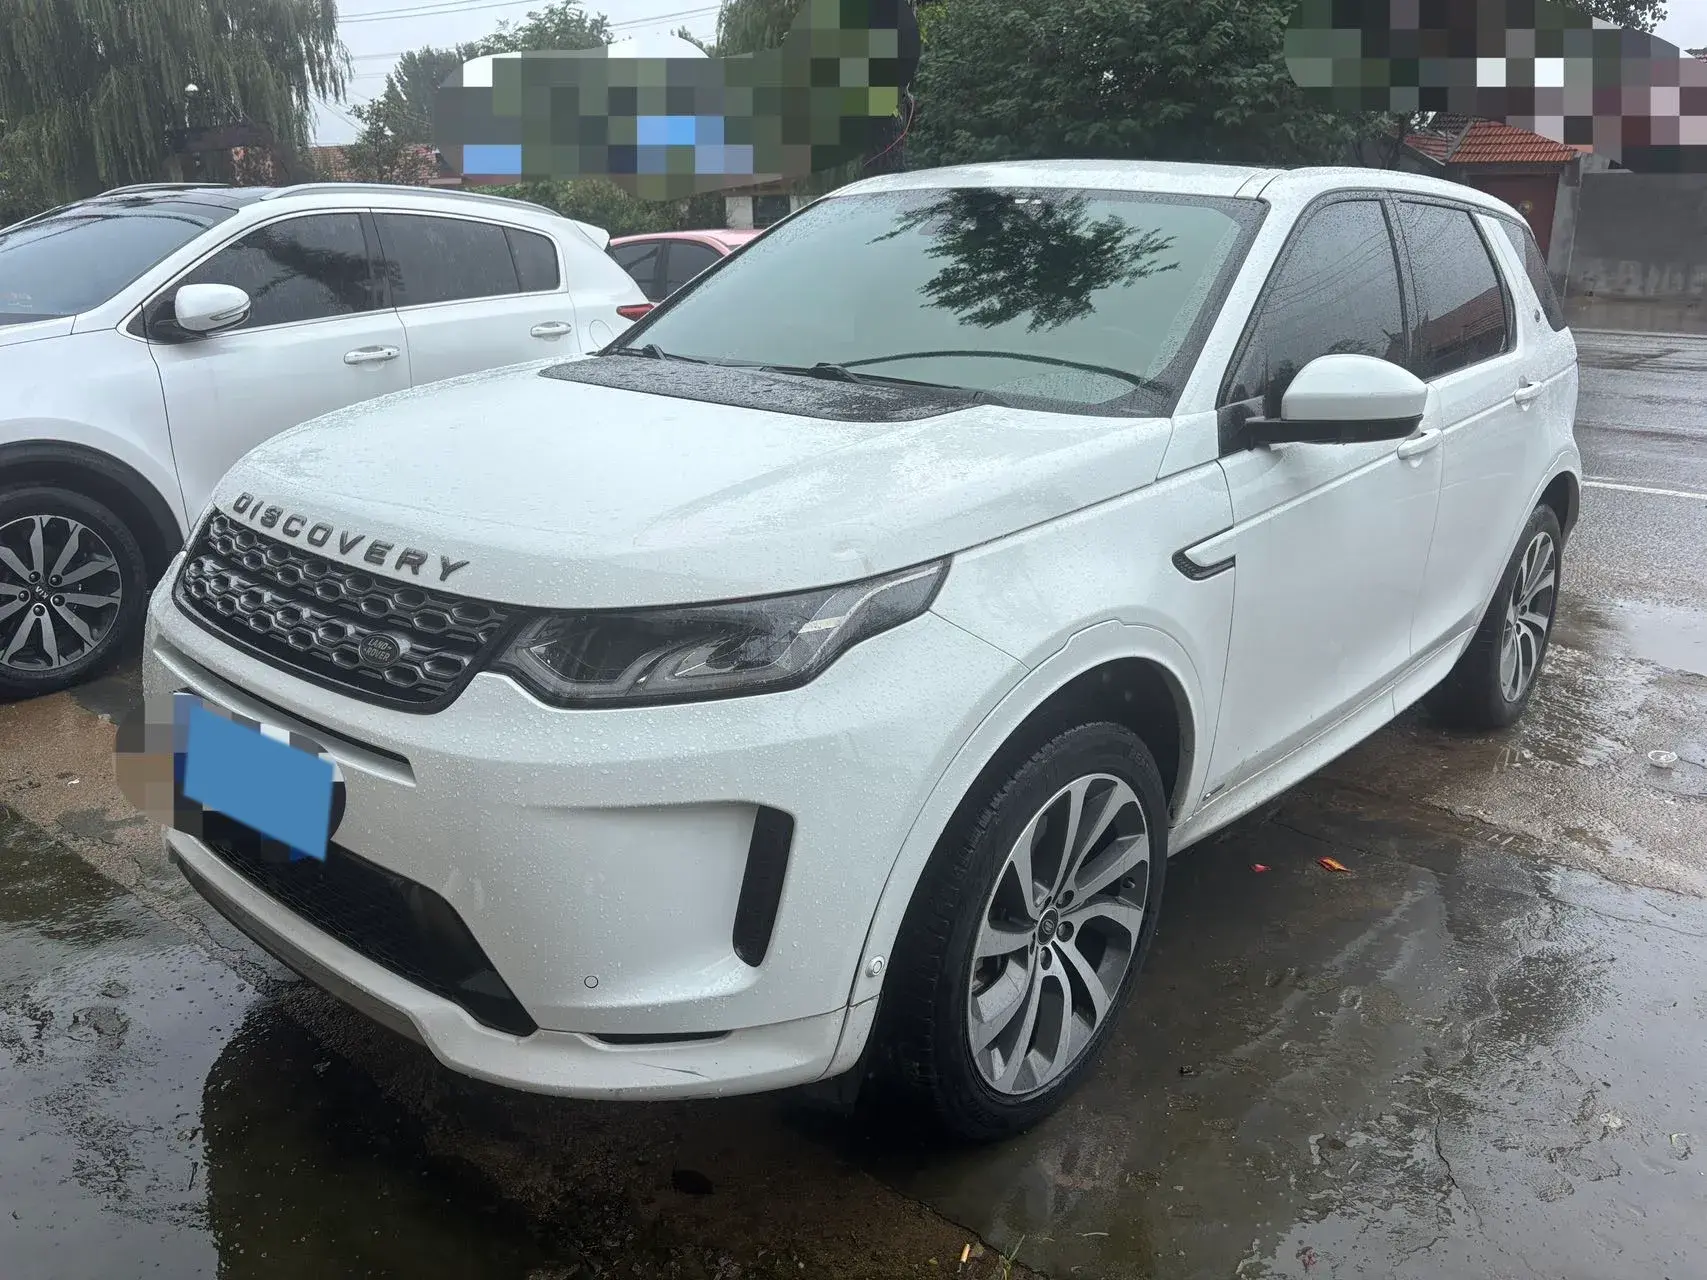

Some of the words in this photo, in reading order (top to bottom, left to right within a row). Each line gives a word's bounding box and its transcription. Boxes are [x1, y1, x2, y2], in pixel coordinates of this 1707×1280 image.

[233, 492, 470, 581] DISCOVERY
[368, 638, 389, 650] LAND
[365, 646, 390, 661] ROVER
